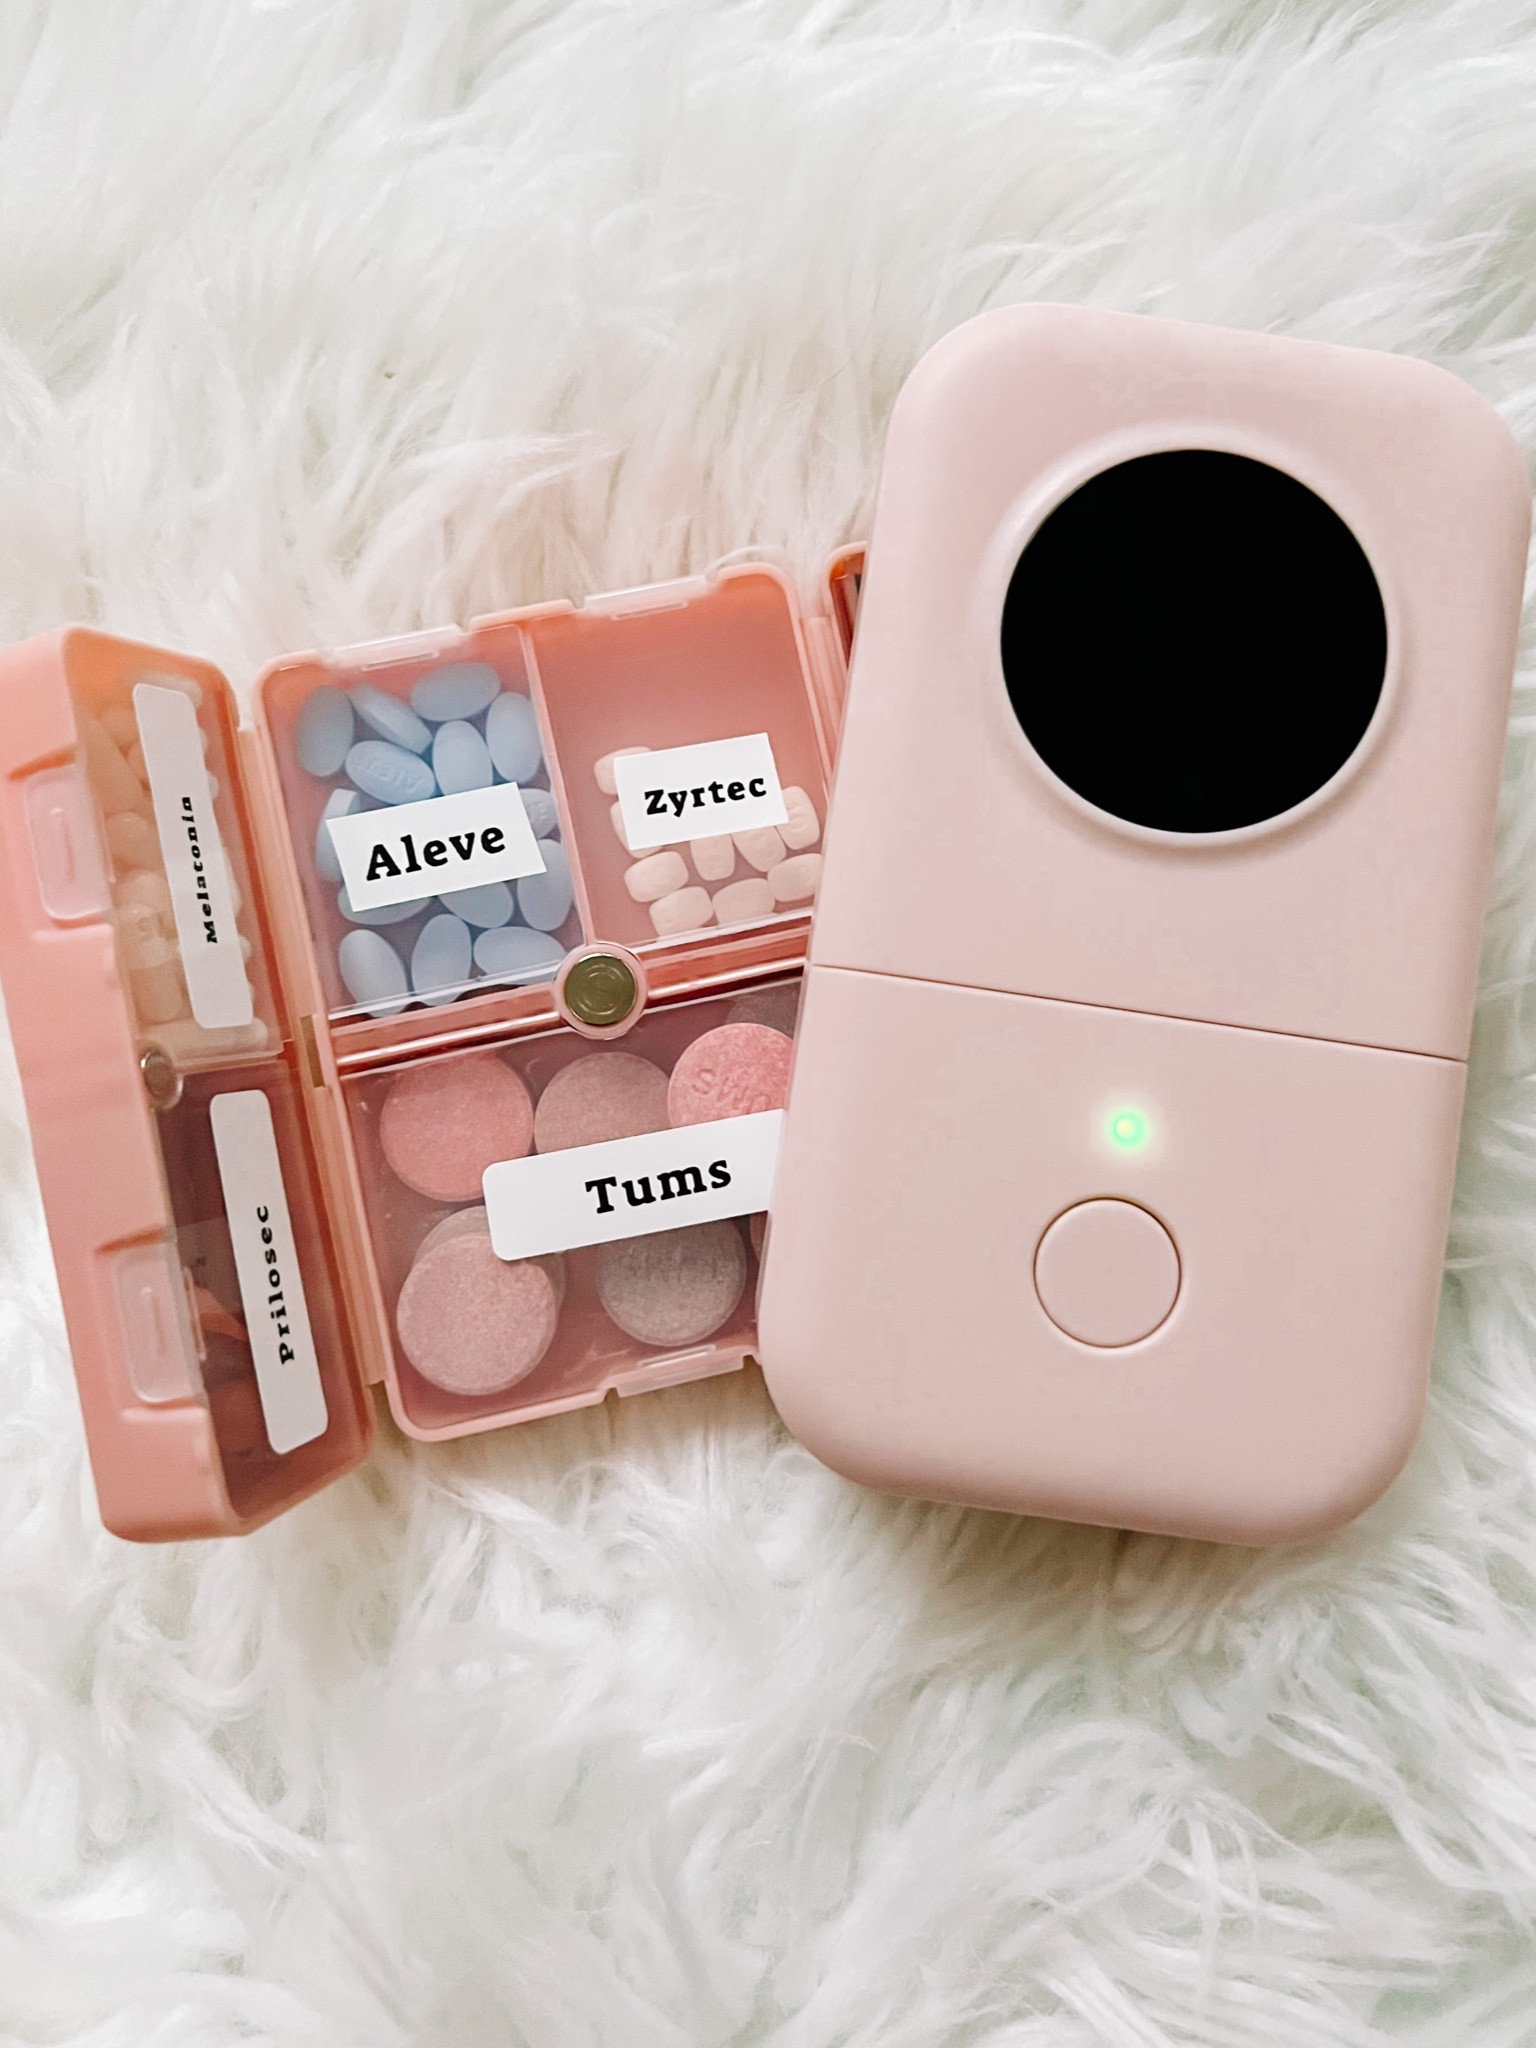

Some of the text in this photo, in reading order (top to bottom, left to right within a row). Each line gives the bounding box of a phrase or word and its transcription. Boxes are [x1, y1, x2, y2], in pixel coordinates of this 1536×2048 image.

[644, 777, 767, 818] Zyrtec
[181, 796, 218, 944] Melatonin
[366, 827, 506, 881] Aleve
[585, 1159, 732, 1214] Tums
[257, 1205, 295, 1365] Prilosec
